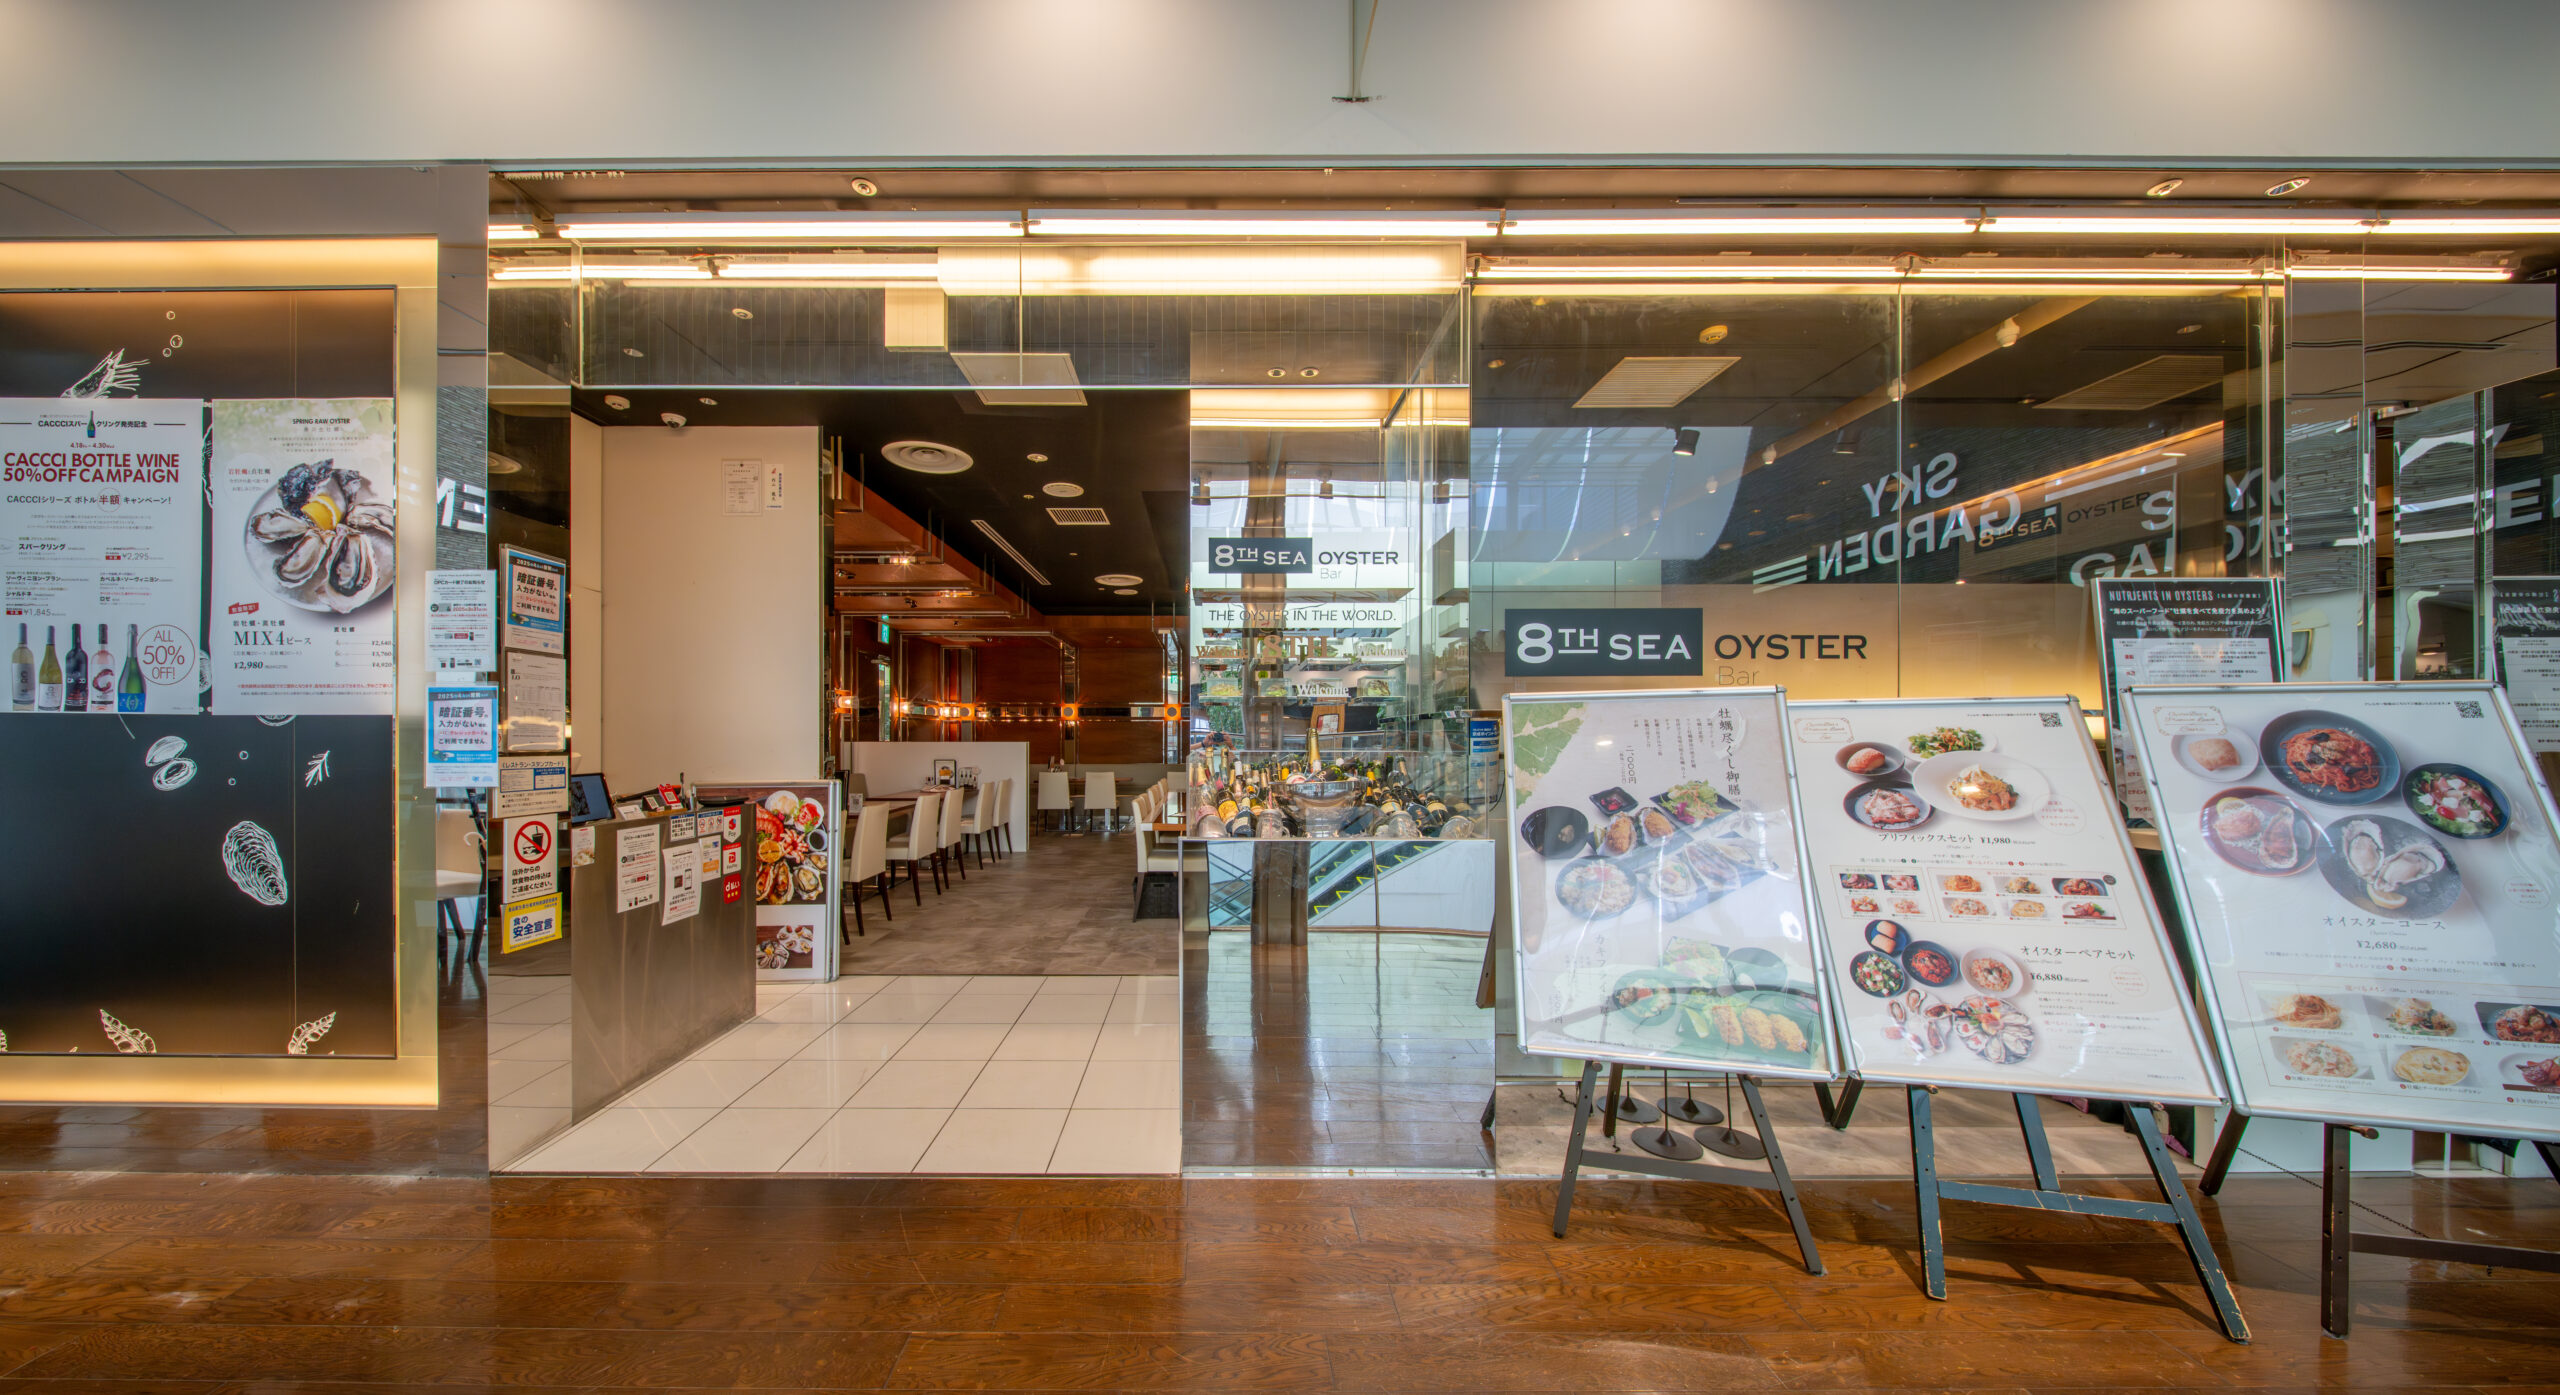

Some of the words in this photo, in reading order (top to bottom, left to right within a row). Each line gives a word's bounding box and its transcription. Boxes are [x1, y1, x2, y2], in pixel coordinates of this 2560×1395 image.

[3, 453, 67, 468] CACCCI
[71, 453, 131, 468] BOTTLE
[136, 453, 180, 468] WINE
[3, 467, 77, 482] 50%OFF
[79, 468, 180, 483] CAMPAIGN
[99, 494, 120, 505] 半額
[2017, 517, 2057, 538] SEA
[1214, 544, 1259, 568] 8TH
[1263, 550, 1307, 566] SEA
[1318, 551, 1399, 566] OYSTER
[1320, 568, 1343, 580] Bar
[2161, 590, 2172, 601] IN
[2174, 590, 2213, 601] OYSTERS
[1208, 610, 1235, 621] THE
[1239, 610, 1288, 621] OYSTER
[1293, 610, 1308, 621] IN
[1311, 610, 1338, 621] THE
[1341, 610, 1397, 621] WORLD.
[153, 630, 175, 642] ALL
[1516, 622, 1599, 664] 8TH
[1609, 633, 1691, 661] SEA
[1714, 633, 1867, 661] OYSTER
[142, 645, 185, 665] 50%
[151, 666, 177, 680] OFF!
[233, 661, 264, 671] ¥2,980
[1717, 665, 1760, 686] Bar
[1296, 684, 1350, 697] Welcome
[1878, 832, 1974, 844] プリフィックスセット
[1980, 837, 2011, 845] ¥1,980
[512, 918, 554, 939] 安全宣言
[2322, 915, 2447, 931] オイスターコース
[2356, 940, 2397, 951] ¥2,680
[2020, 945, 2136, 961] オイスターペアセット
[2029, 972, 2063, 982] ¥6,880
